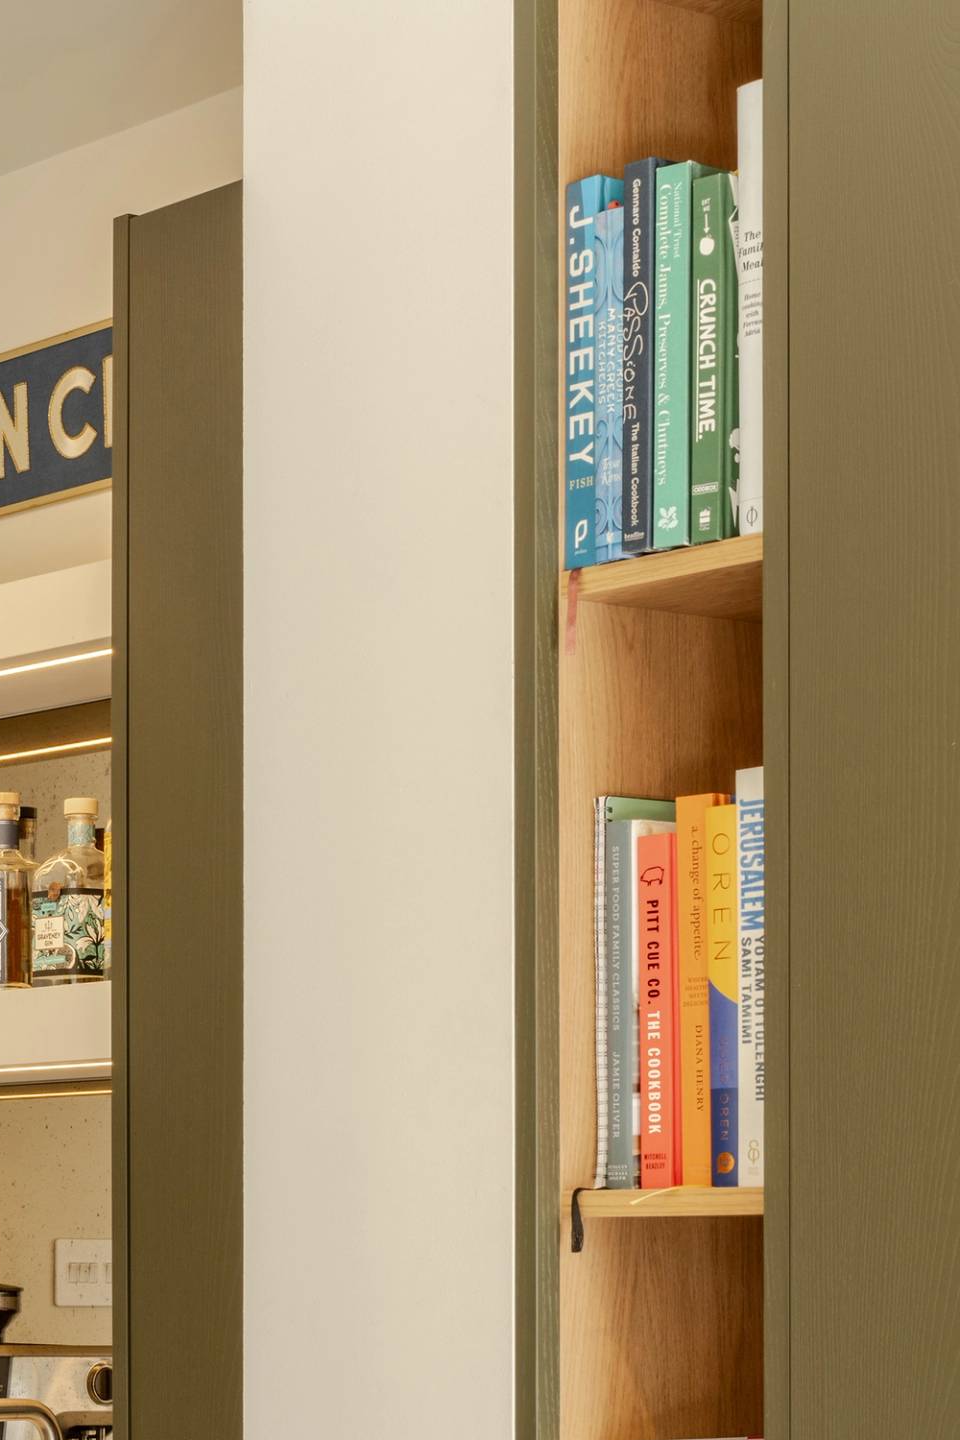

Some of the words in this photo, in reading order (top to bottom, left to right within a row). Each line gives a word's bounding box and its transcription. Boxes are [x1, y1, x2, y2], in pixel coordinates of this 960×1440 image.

[632, 178, 641, 226] Gennaro
[657, 183, 672, 258] Complete
[632, 228, 641, 278] Contaldo
[744, 230, 761, 242] The
[657, 264, 672, 310] Jams,
[606, 308, 616, 353] MANY
[699, 278, 716, 369] CRUNCH
[597, 320, 606, 404] KITCHENS
[657, 313, 671, 390] Preserves
[606, 356, 615, 413] GREEK
[657, 394, 671, 407] &
[631, 422, 640, 442] The
[655, 410, 670, 486] Chutneys
[630, 443, 640, 475] Italian
[569, 476, 594, 491] FISH
[631, 477, 640, 526] Cookbook
[611, 846, 620, 884] SUPER
[689, 840, 703, 883] change
[740, 799, 764, 931] JERUSALEM
[611, 888, 620, 921] FOOD
[646, 900, 659, 932] PITT
[692, 887, 704, 902] of
[712, 833, 731, 960] OREN
[611, 925, 621, 969] FAMILY
[647, 941, 660, 970] CUE
[742, 937, 752, 977] SAMI
[612, 971, 621, 1031] CLASSICS
[647, 978, 660, 1005] CO.
[742, 980, 752, 1044] TAMIMI
[647, 1011, 661, 1040] THE
[696, 1025, 704, 1066] DIANA
[612, 1051, 621, 1090] JAMIE
[647, 1047, 662, 1134] COOKBOOK
[696, 1069, 705, 1112] HENRY
[612, 1092, 621, 1139] OLIVER
